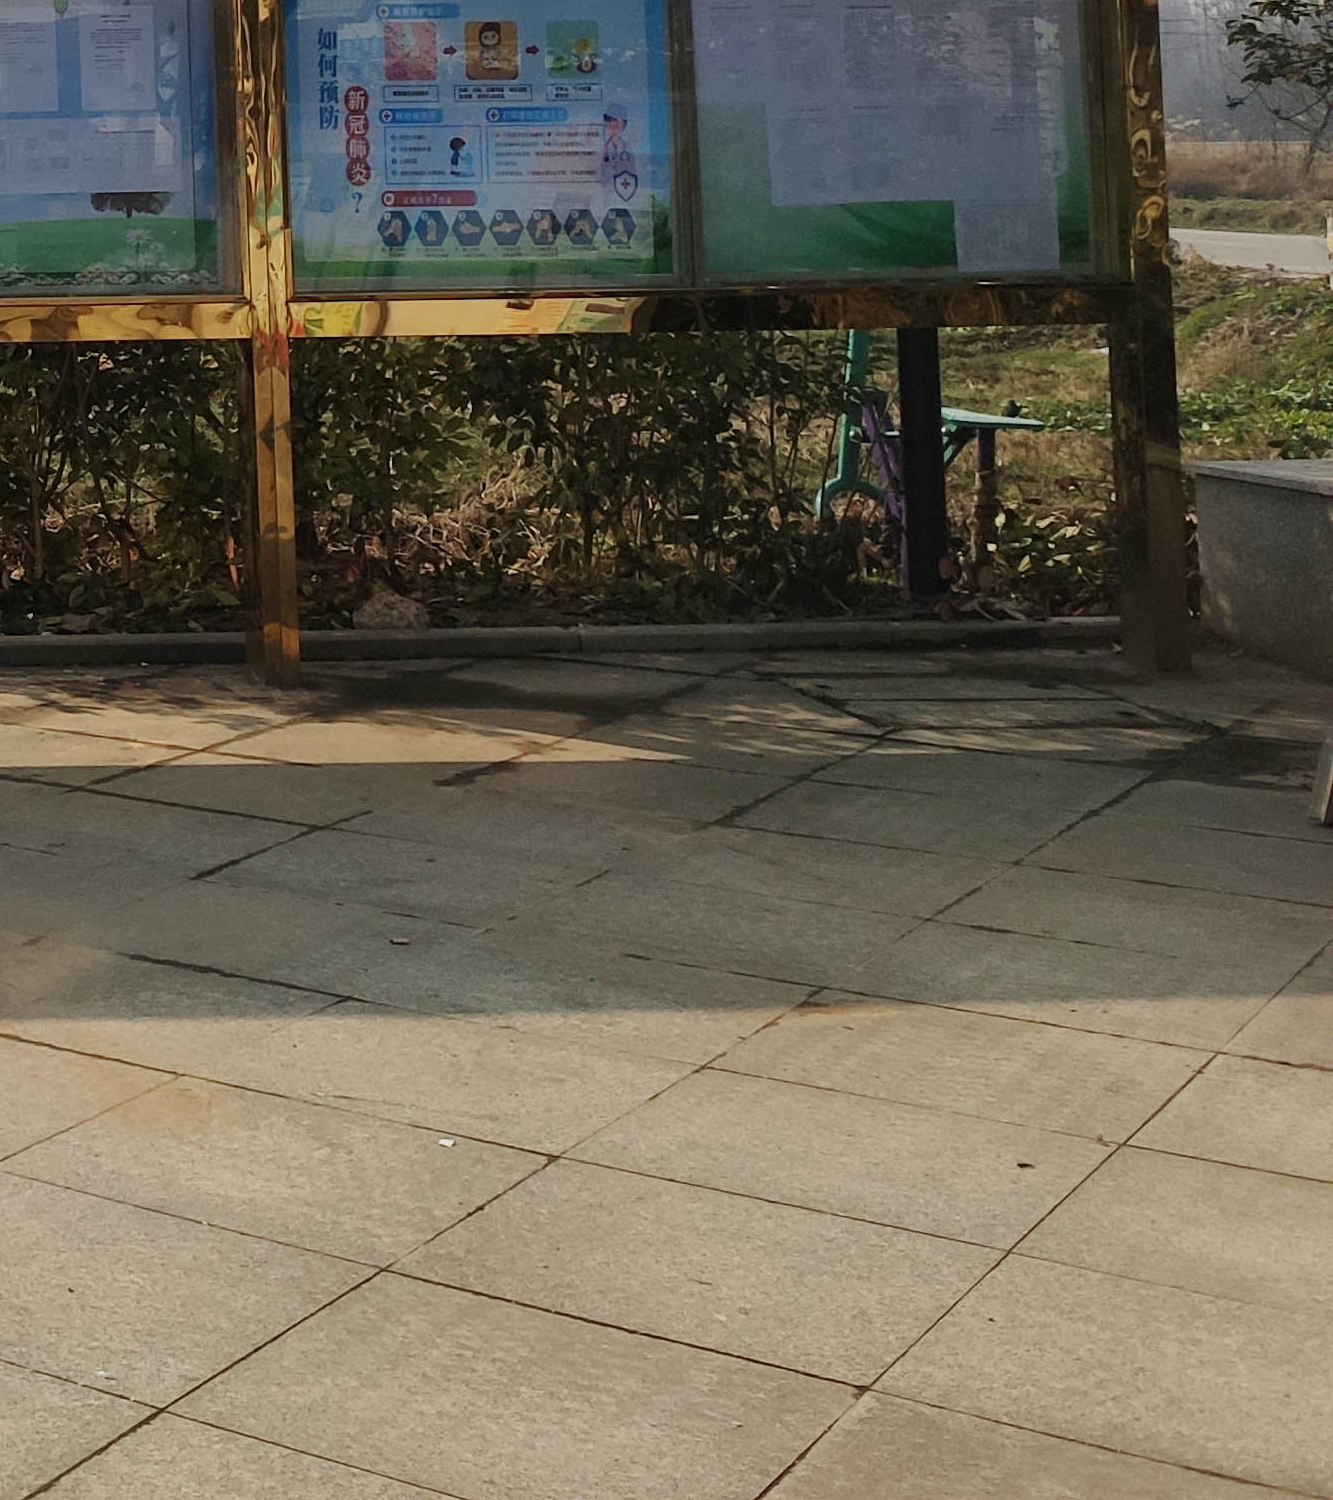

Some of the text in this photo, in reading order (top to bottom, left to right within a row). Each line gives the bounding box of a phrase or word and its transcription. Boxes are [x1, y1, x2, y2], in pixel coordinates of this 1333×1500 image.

[317, 27, 339, 131] 如何预防
[347, 88, 370, 184] 新冠肺炎
